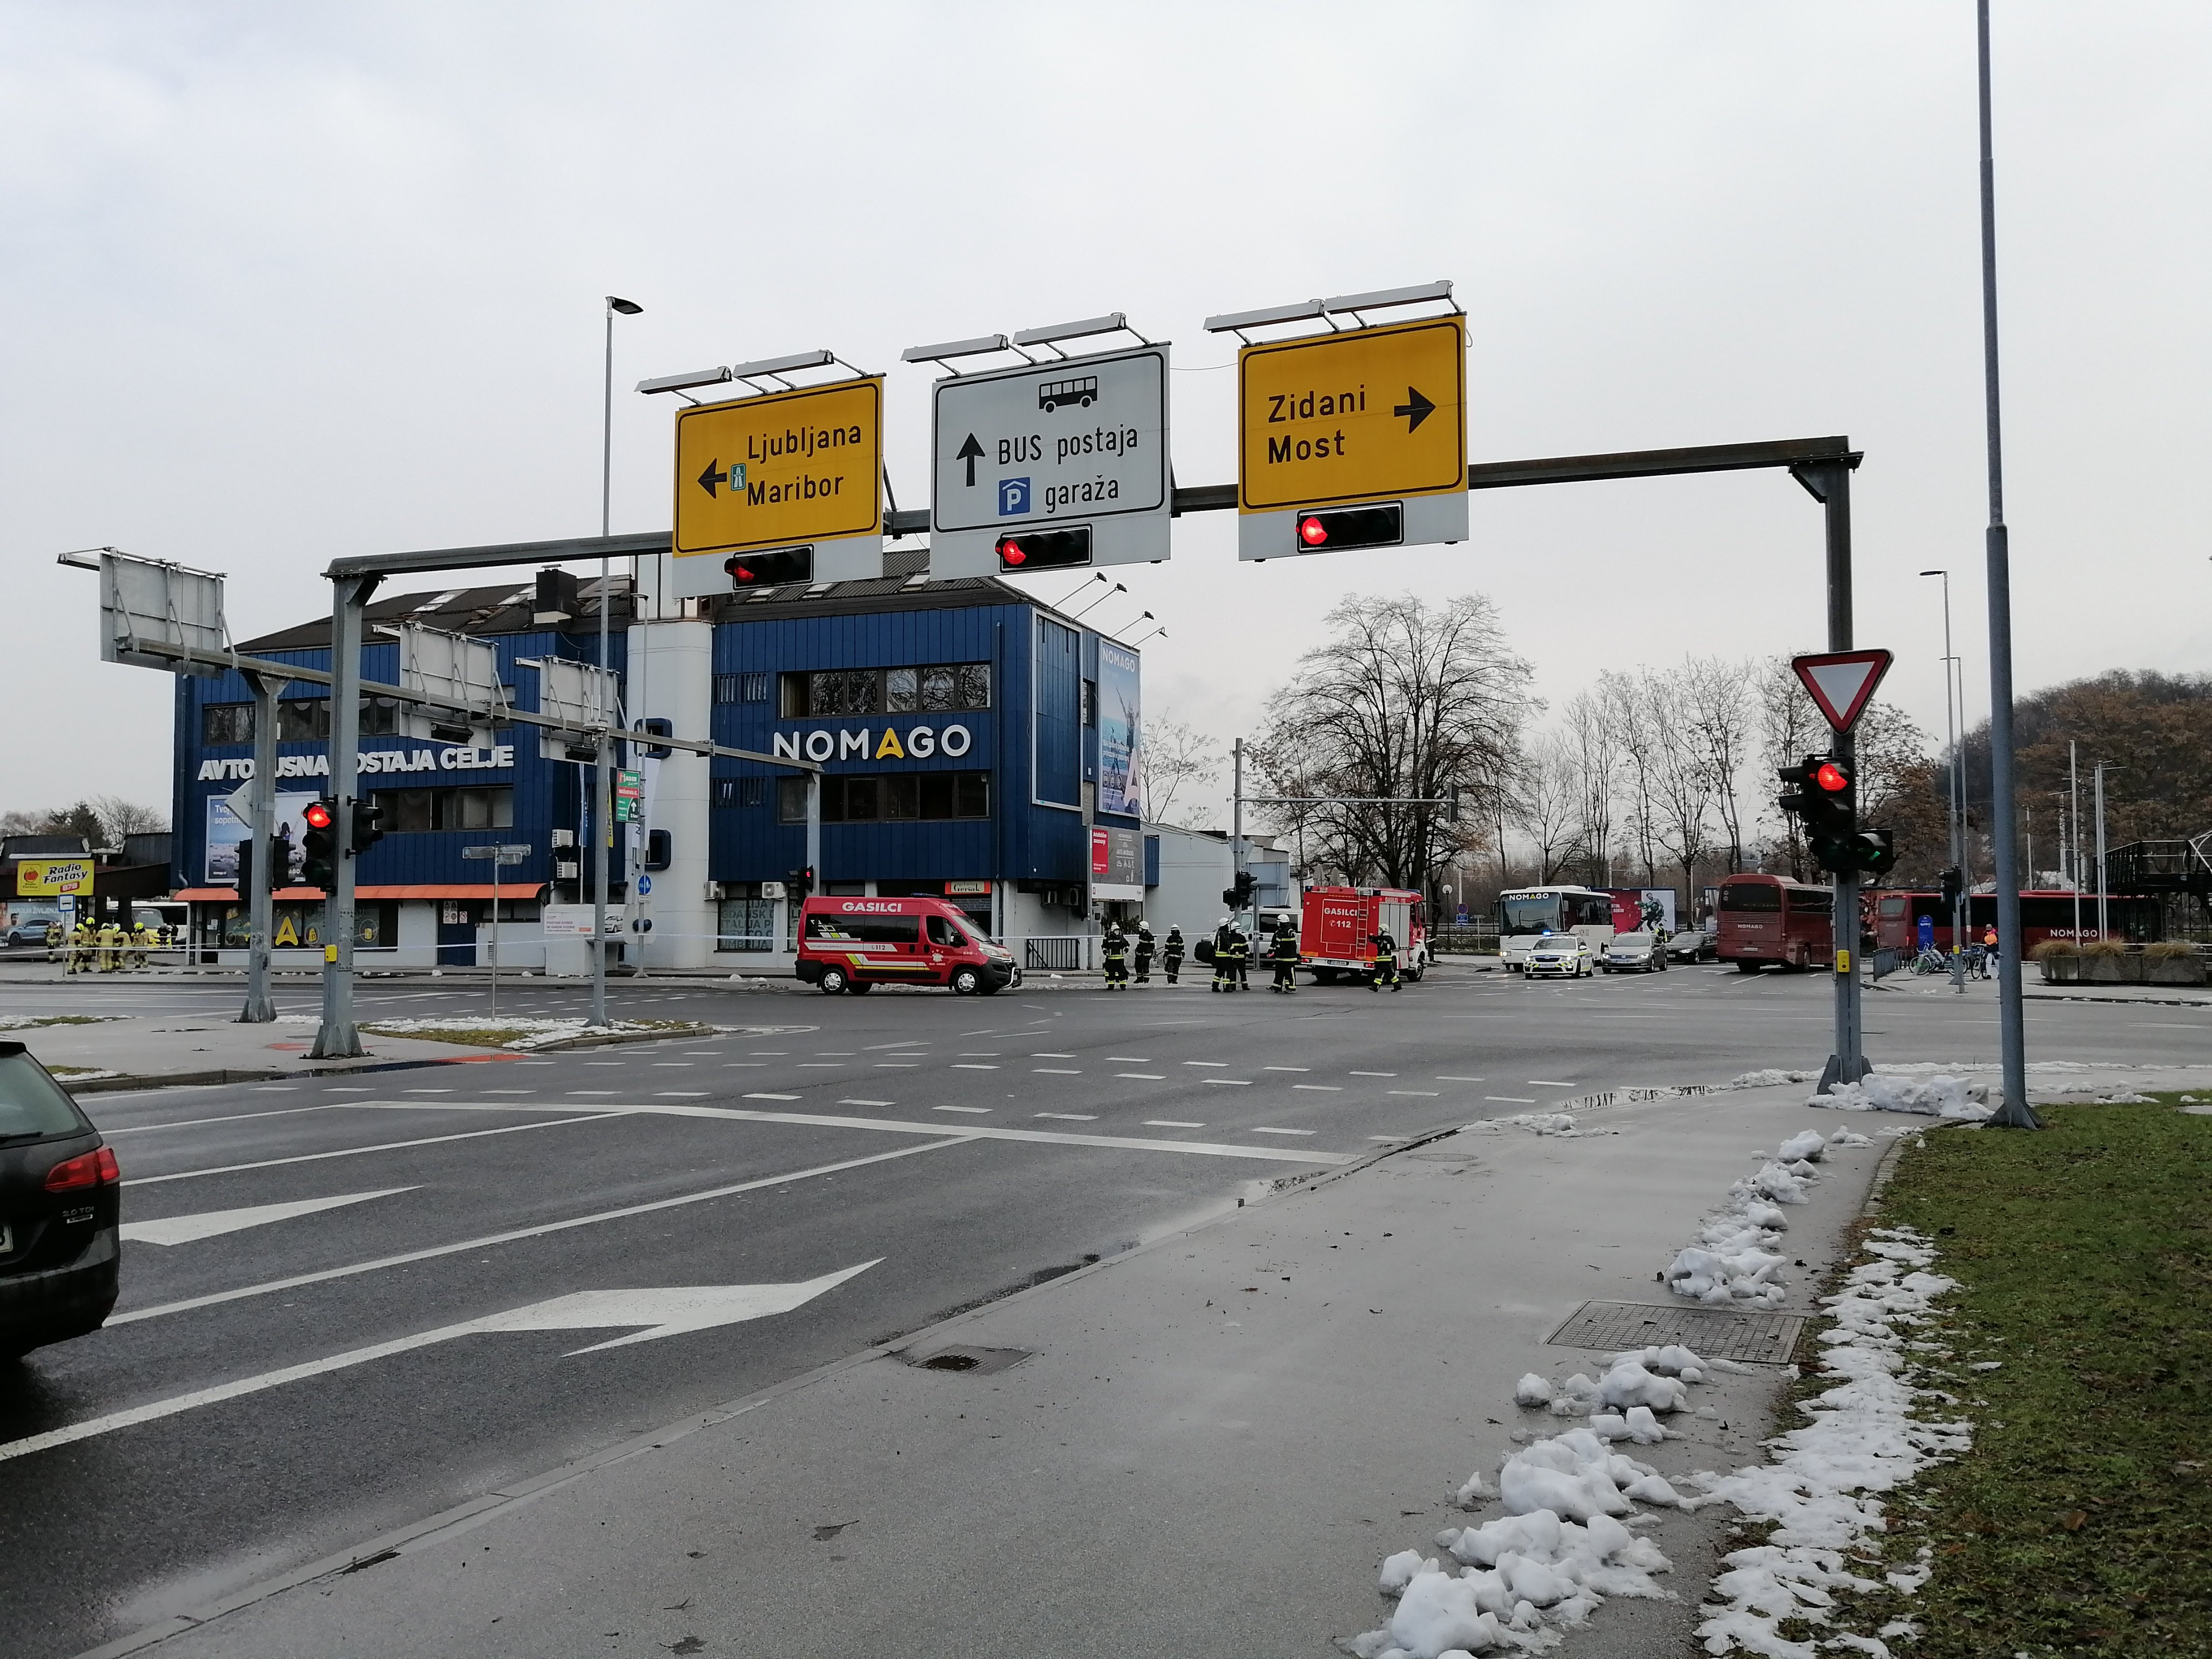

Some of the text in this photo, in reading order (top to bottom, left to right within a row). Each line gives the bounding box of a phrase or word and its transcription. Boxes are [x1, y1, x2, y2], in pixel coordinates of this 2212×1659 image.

[1268, 383, 1366, 423] Zidani
[747, 425, 861, 464] Ljubljana
[998, 423, 1138, 466] BUS postaja
[1268, 428, 1346, 464] Most
[747, 474, 844, 507] Maribor
[1006, 474, 1119, 514] P garaža
[1102, 646, 1135, 673] NOMAGO
[773, 724, 971, 761] NOMAGO
[198, 745, 514, 781] AVTOUSNA OSTAJA CELJE
[43, 871, 88, 884] Fantasy
[49, 864, 82, 875] Radio
[953, 883, 980, 892] Geršak
[1509, 893, 1549, 901] NOMAGO
[842, 902, 902, 913] GASILCI
[1324, 907, 1357, 916] GASILCI
[1336, 920, 1351, 928] 112
[79, 1206, 95, 1214] TDI
